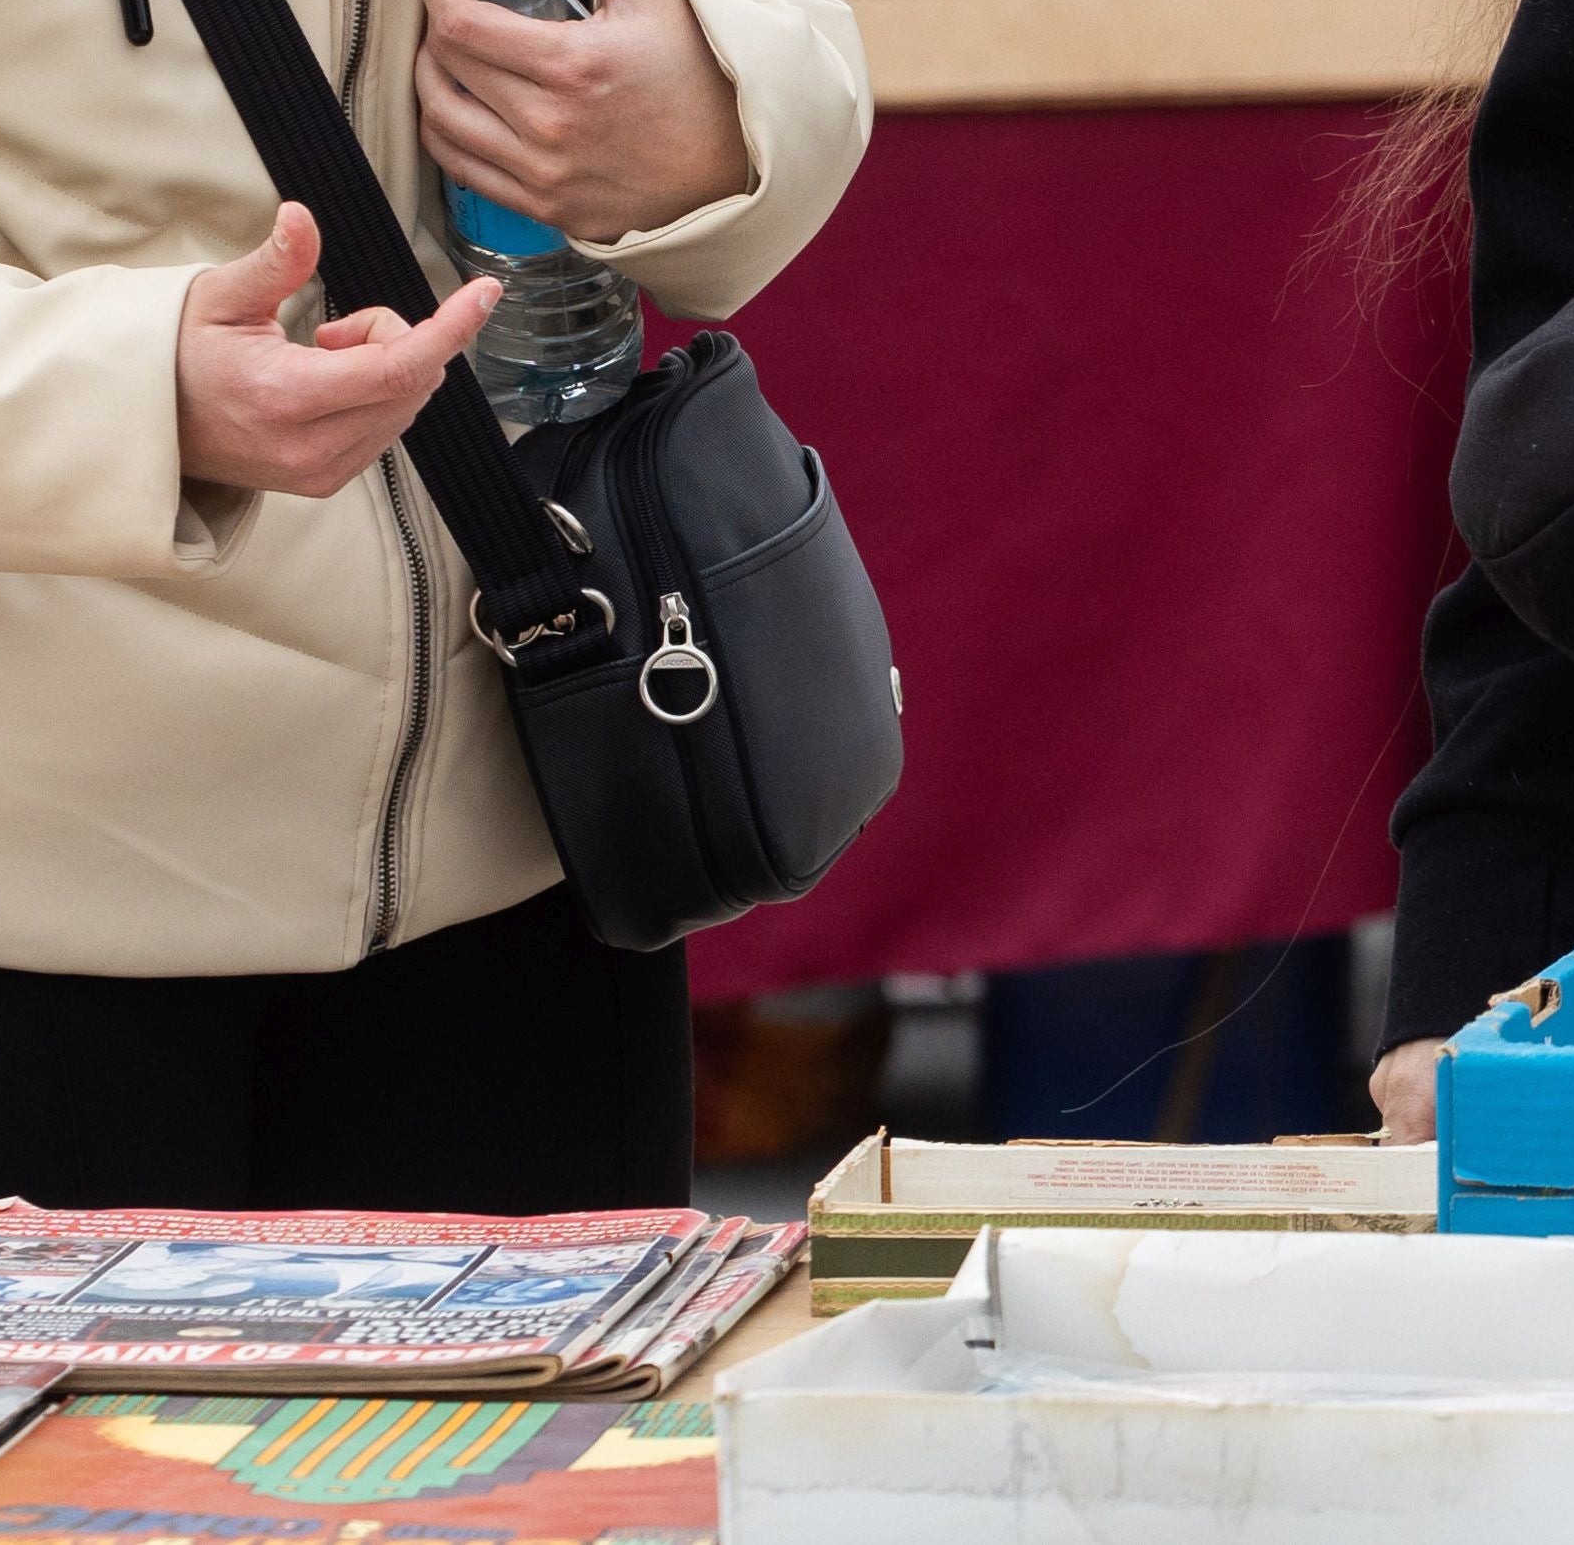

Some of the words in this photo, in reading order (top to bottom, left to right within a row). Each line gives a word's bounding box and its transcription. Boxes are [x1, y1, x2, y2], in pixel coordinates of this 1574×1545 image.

[78, 1226, 183, 1234] NUEVA
[168, 1223, 256, 1231] DESFILES
[102, 1233, 262, 1242] EMPERADORES
[23, 1304, 144, 1314] PORTADAS
[146, 1306, 193, 1315] LAS
[194, 1307, 229, 1316] DE
[327, 1310, 344, 1318] A
[348, 1310, 454, 1319] HISTORIA
[459, 1311, 492, 1319] DE
[231, 1344, 304, 1361] 50
